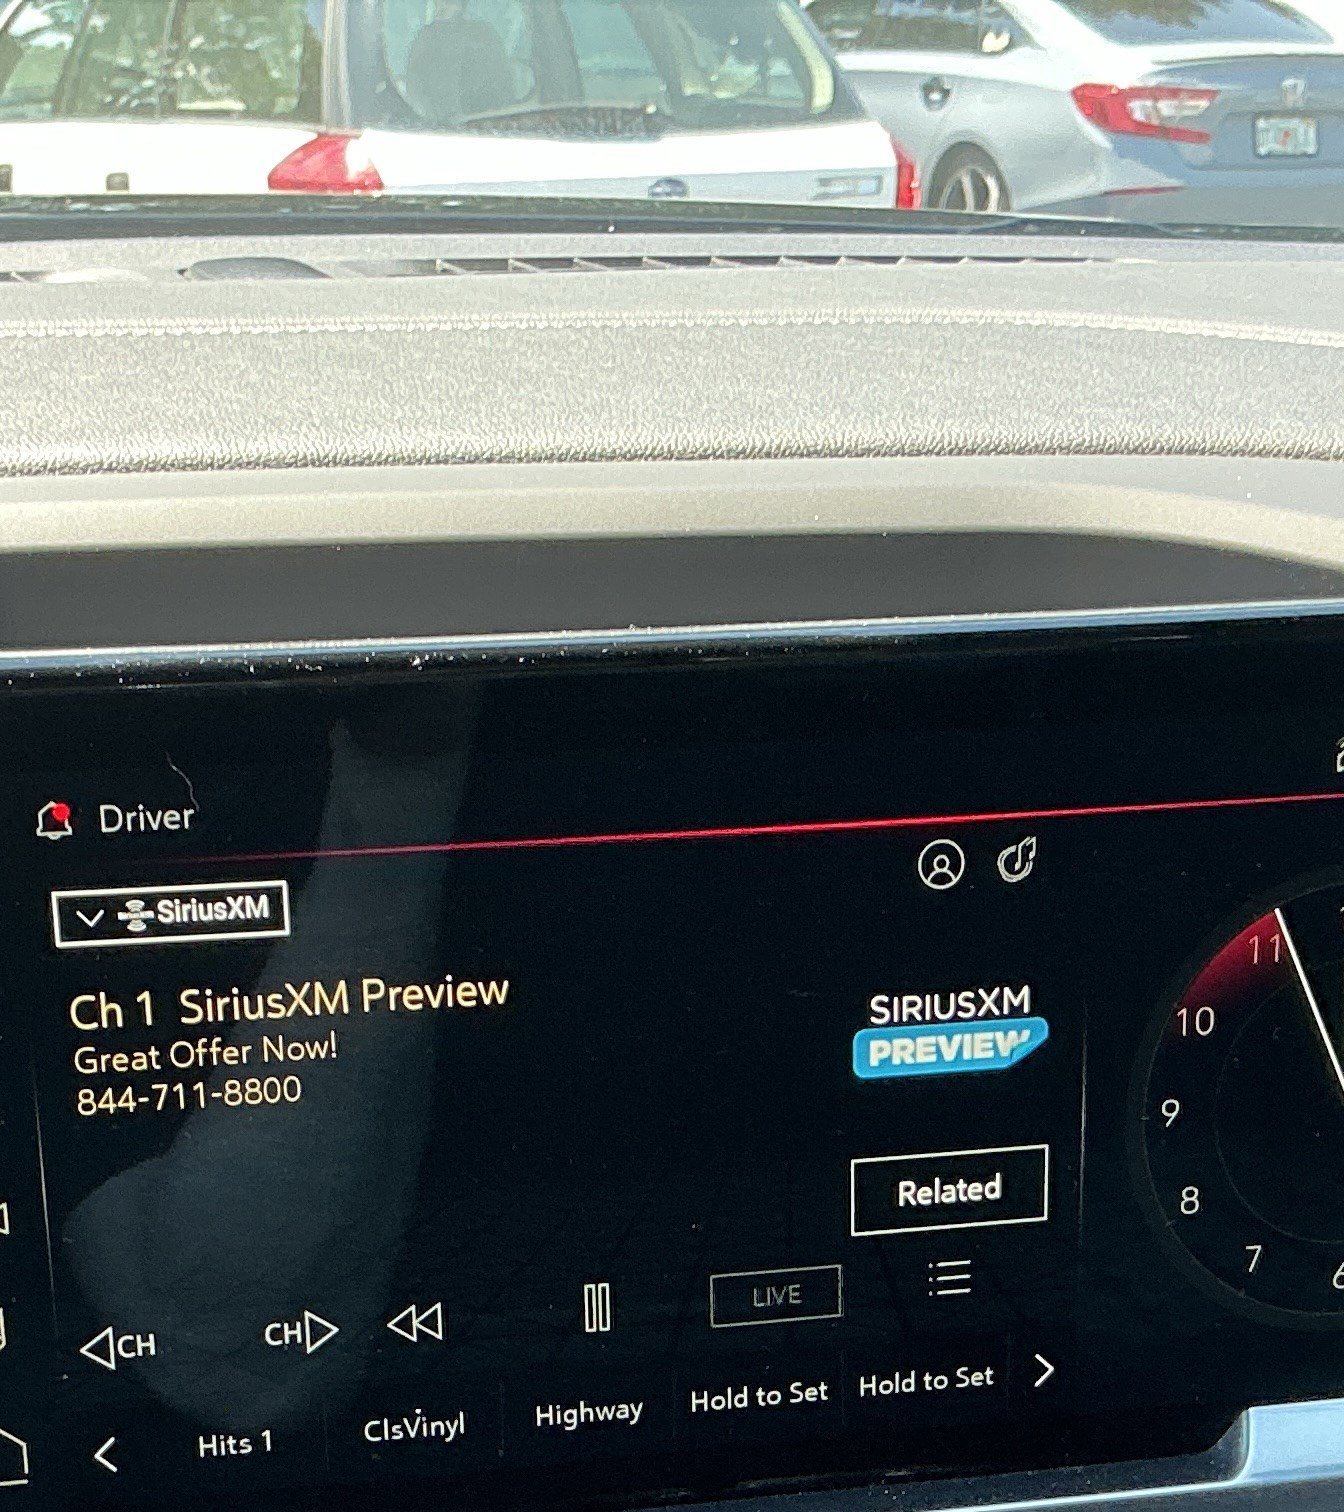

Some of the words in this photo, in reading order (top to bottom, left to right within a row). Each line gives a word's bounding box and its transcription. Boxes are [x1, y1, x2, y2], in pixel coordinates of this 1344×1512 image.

[99, 804, 195, 834] Driver
[157, 894, 270, 924] SiriusXM
[1249, 933, 1281, 964] 11
[70, 993, 124, 1032] Ch
[136, 994, 154, 1026] 1
[179, 980, 350, 1025] SiriusXM
[362, 974, 510, 1013] Preview
[870, 985, 1031, 1025] SIRIUSXM
[1177, 1006, 1215, 1036] 10
[73, 1043, 161, 1076] Great
[170, 1038, 252, 1069] Offer
[262, 1031, 338, 1063] Now!
[869, 1029, 1031, 1067] PREVIEW
[77, 1075, 302, 1116] 844-711-8800
[1161, 1099, 1180, 1128] 9
[897, 1173, 1004, 1208] Related
[1180, 1186, 1200, 1215] 8
[1245, 1244, 1262, 1273] 7
[753, 1284, 803, 1307] LIVE
[117, 1332, 155, 1358] CH
[264, 1321, 302, 1347] CH
[691, 1388, 749, 1413] Hold
[756, 1388, 782, 1407] to
[789, 1382, 829, 1404] Set
[859, 1372, 916, 1398] Hold
[923, 1371, 949, 1391] to
[956, 1366, 995, 1388] Set
[363, 1413, 465, 1444] ClsVinyl
[536, 1399, 644, 1431] Highway
[198, 1433, 253, 1458] Hits
[261, 1429, 272, 1452] 1
